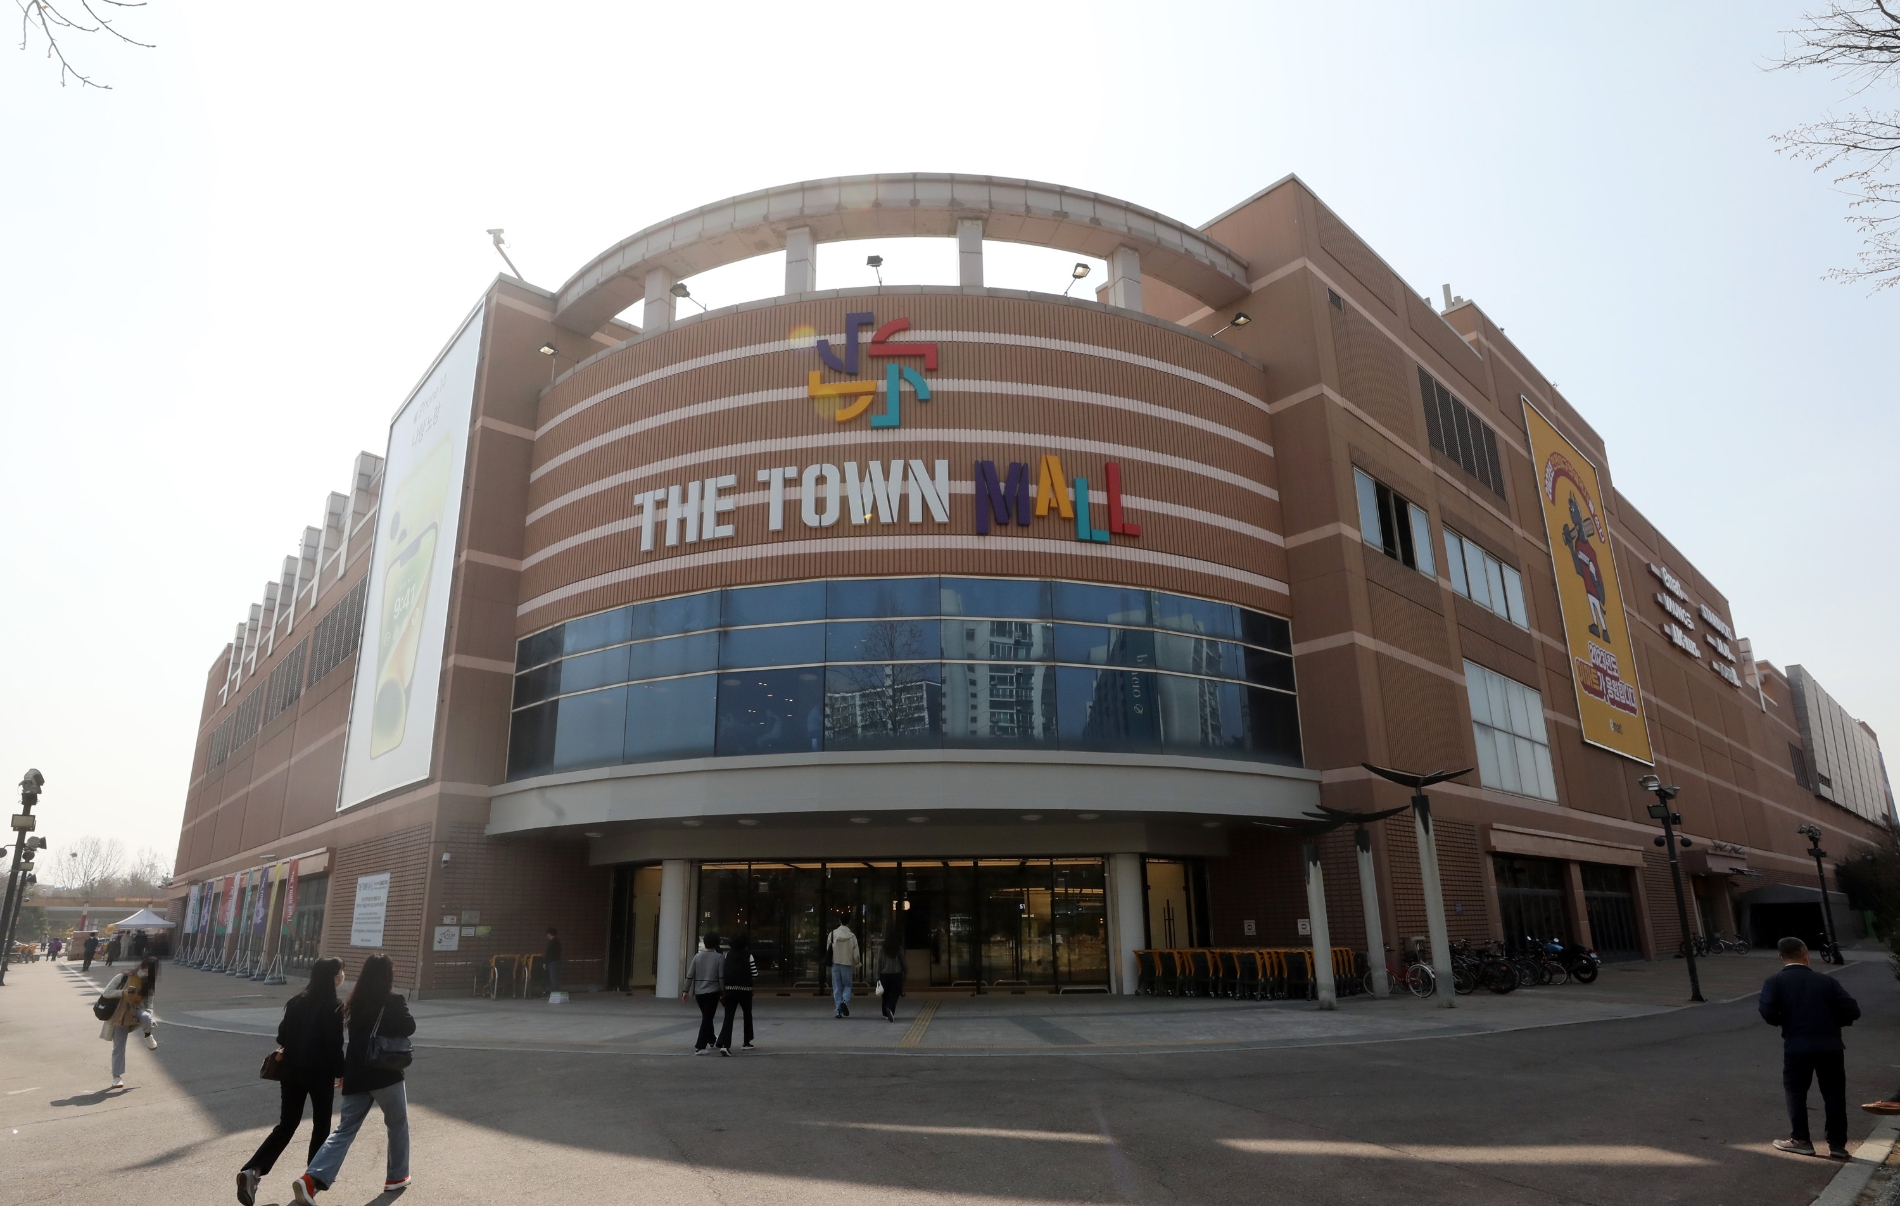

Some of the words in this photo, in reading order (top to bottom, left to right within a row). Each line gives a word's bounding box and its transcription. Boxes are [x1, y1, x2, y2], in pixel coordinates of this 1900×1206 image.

[634, 474, 737, 552] THE
[757, 459, 949, 532] TOWN
[974, 454, 1141, 543] MALL
[394, 583, 416, 619] 9:41
